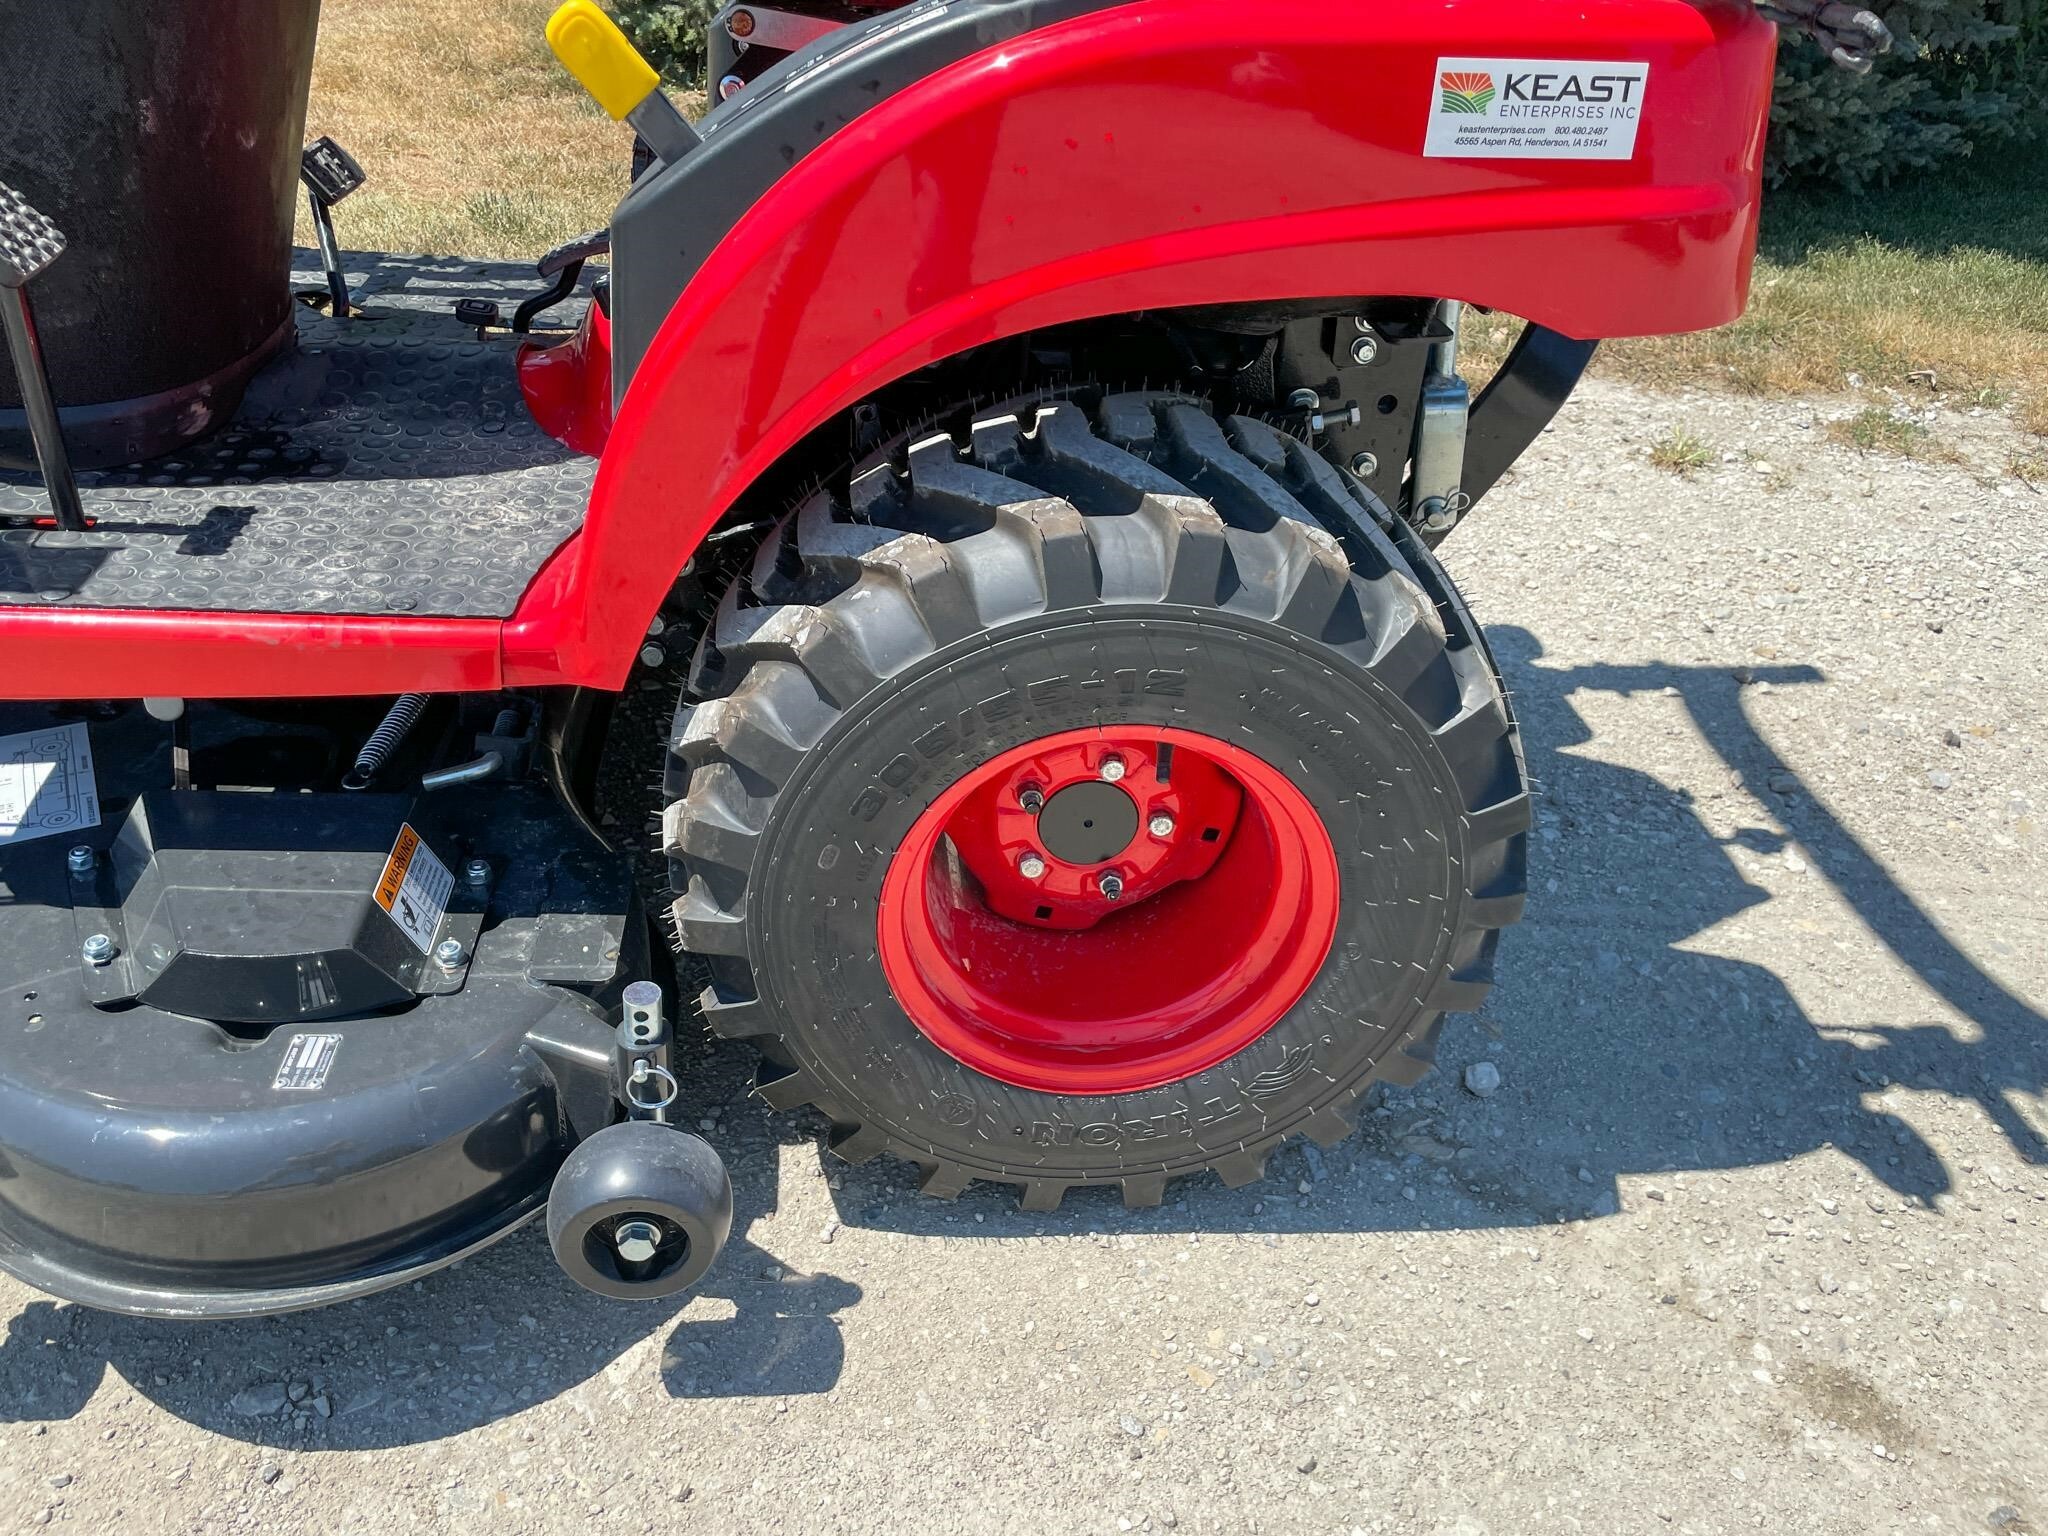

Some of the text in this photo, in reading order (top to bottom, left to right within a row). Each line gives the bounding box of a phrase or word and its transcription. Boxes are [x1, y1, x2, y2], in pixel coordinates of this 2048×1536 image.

[1503, 74, 1640, 102] KEAST
[1500, 105, 1636, 119] ENTERPRISES INC
[1458, 124, 1608, 136] keastenterprises.com 800.480.2487
[1454, 137, 1607, 148] 45565 Aspen Rd, Henderson, IA 51541
[387, 835, 414, 887] WARNING
